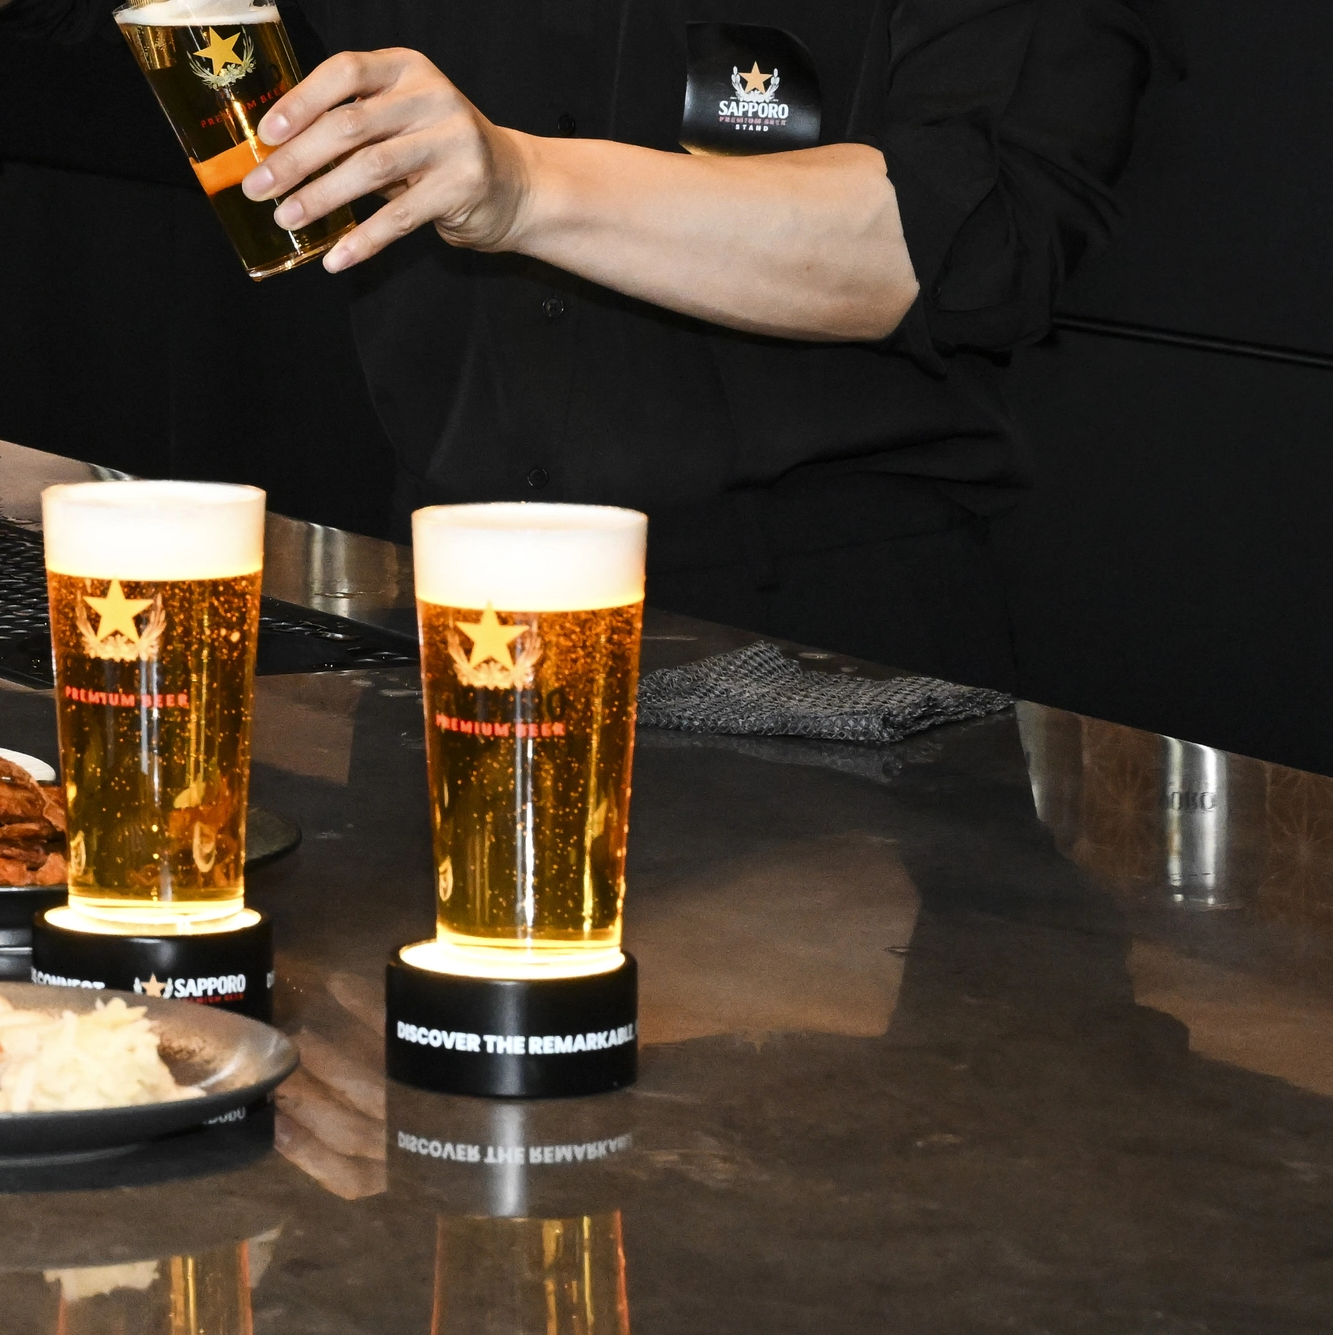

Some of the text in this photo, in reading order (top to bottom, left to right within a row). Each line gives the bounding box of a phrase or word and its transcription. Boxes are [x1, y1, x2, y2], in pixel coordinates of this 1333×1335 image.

[718, 100, 789, 119] SAPPORO
[719, 116, 762, 125] PREMIUM
[735, 124, 769, 132] STAND
[65, 685, 189, 708] PREMIUM BEER
[435, 713, 565, 738] PREMIUM BEER
[174, 973, 246, 998] SAPPORO
[397, 1020, 481, 1053] DISCOVER
[483, 1034, 525, 1055] THE
